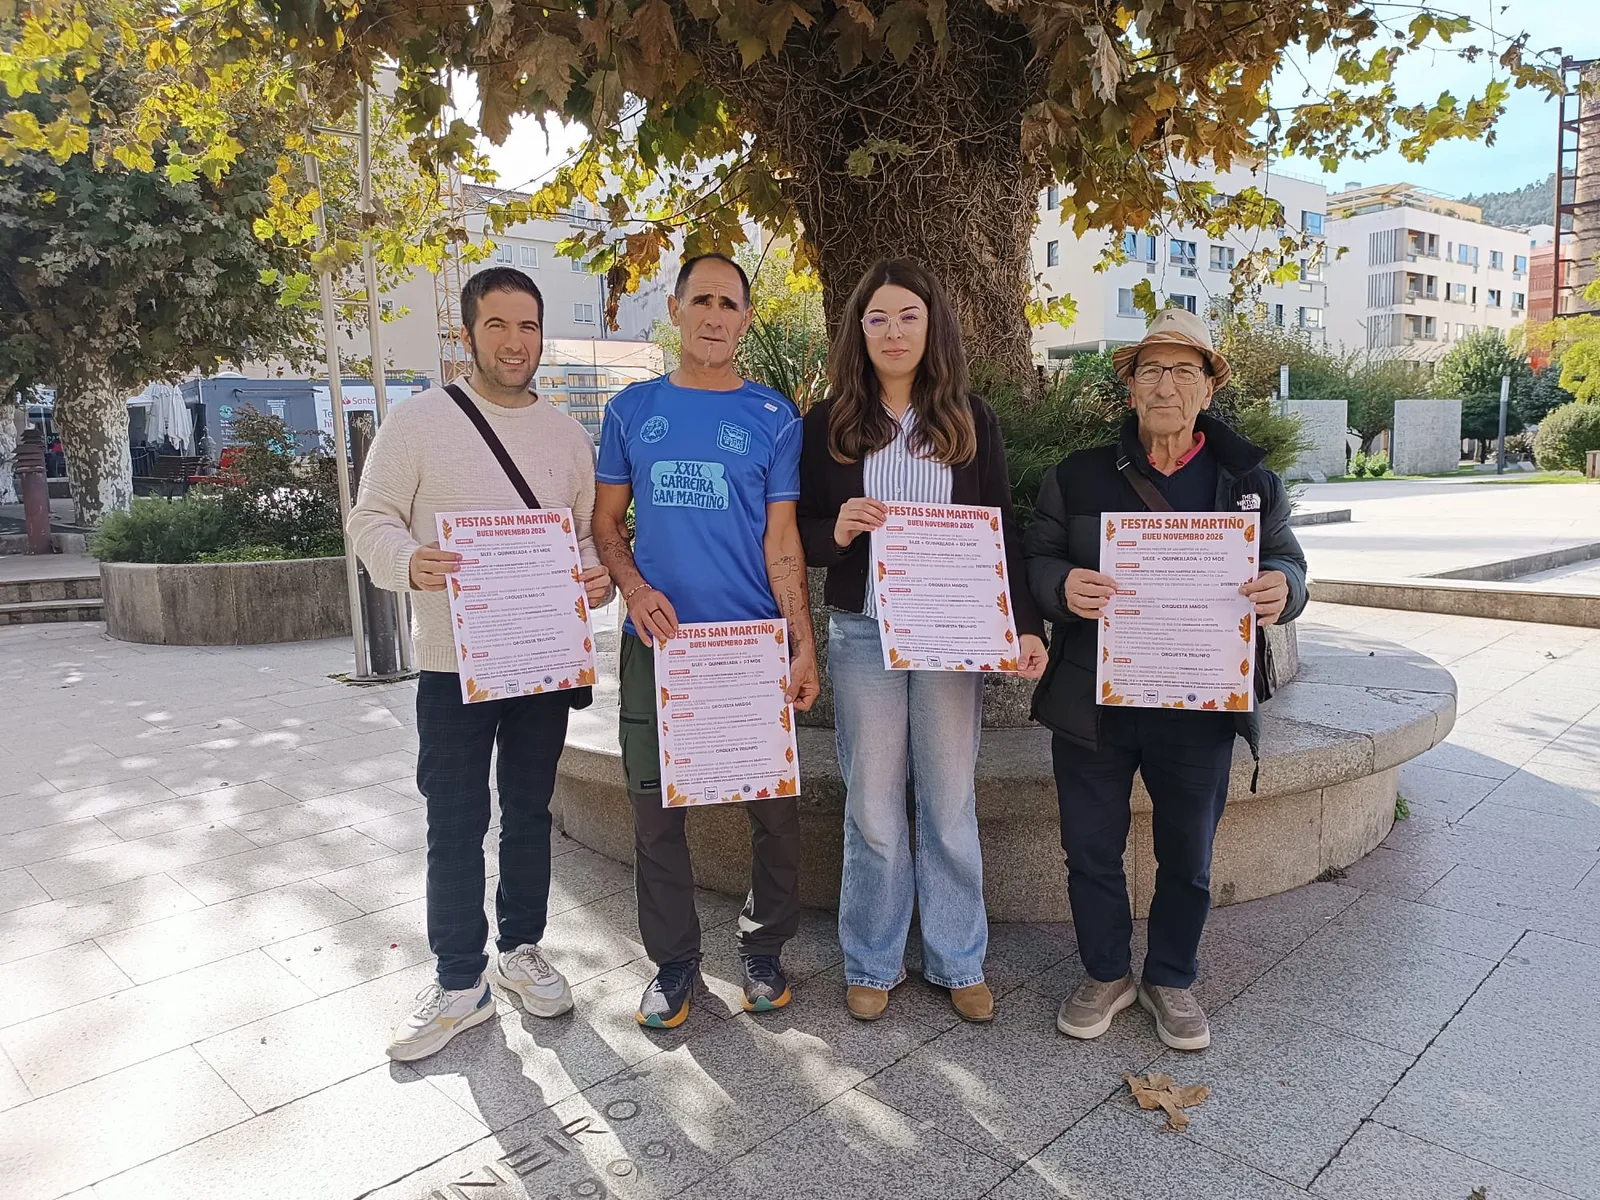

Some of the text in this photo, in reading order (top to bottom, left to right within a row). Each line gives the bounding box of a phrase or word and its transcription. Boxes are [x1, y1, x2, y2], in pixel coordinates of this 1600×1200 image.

[674, 461, 704, 478] XXIX
[661, 475, 714, 493] CARREIRA
[653, 489, 674, 504] SAN
[455, 511, 561, 528] FESTAS SAN MARTIÑO
[888, 506, 990, 521] FESTAS SAN MARTIÑO
[907, 519, 974, 529] BUEU NOVEMBRO 2026
[1120, 516, 1245, 529] FESTAS SAN MARTIÑO
[476, 527, 546, 537] BUEU NOVEMBRO 2026
[1163, 533, 1205, 541] NOVEMBRO
[1205, 533, 1224, 541] 2026
[674, 622, 775, 640] ESTAS SAN MARTIÑO
[689, 638, 759, 649] BUEU NOVEMBRO 2026
